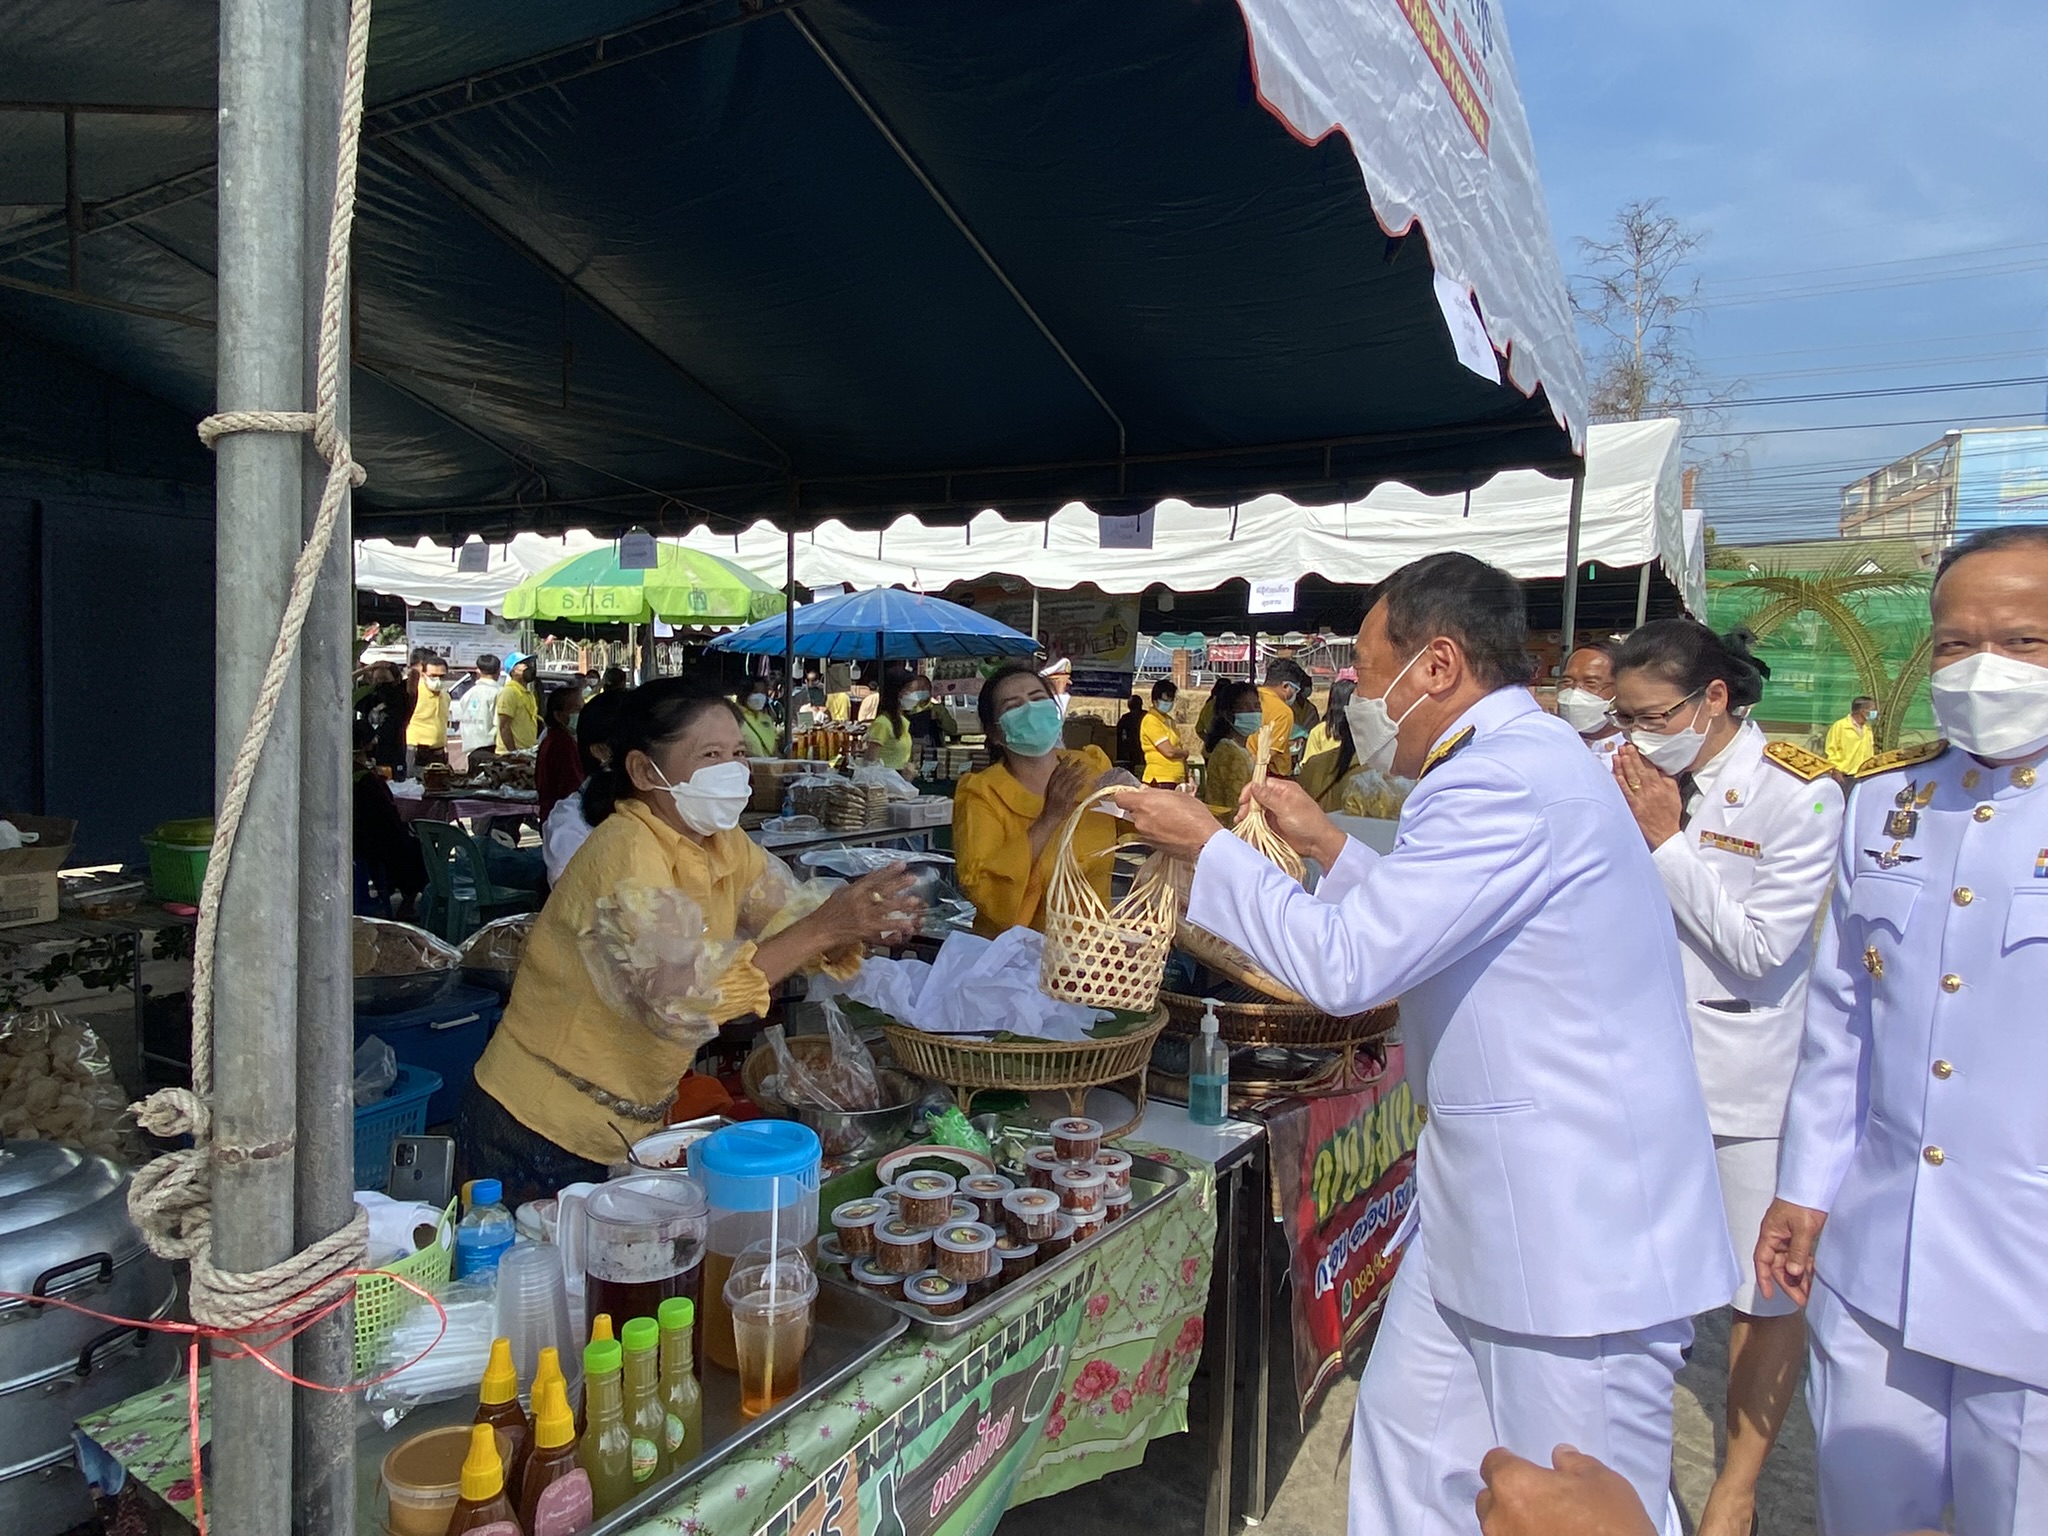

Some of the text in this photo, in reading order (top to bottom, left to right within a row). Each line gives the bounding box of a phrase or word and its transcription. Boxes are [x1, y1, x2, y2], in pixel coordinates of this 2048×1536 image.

[1315, 1228, 1349, 1299] กอบ
[930, 1406, 1015, 1518] ขนมไทย
